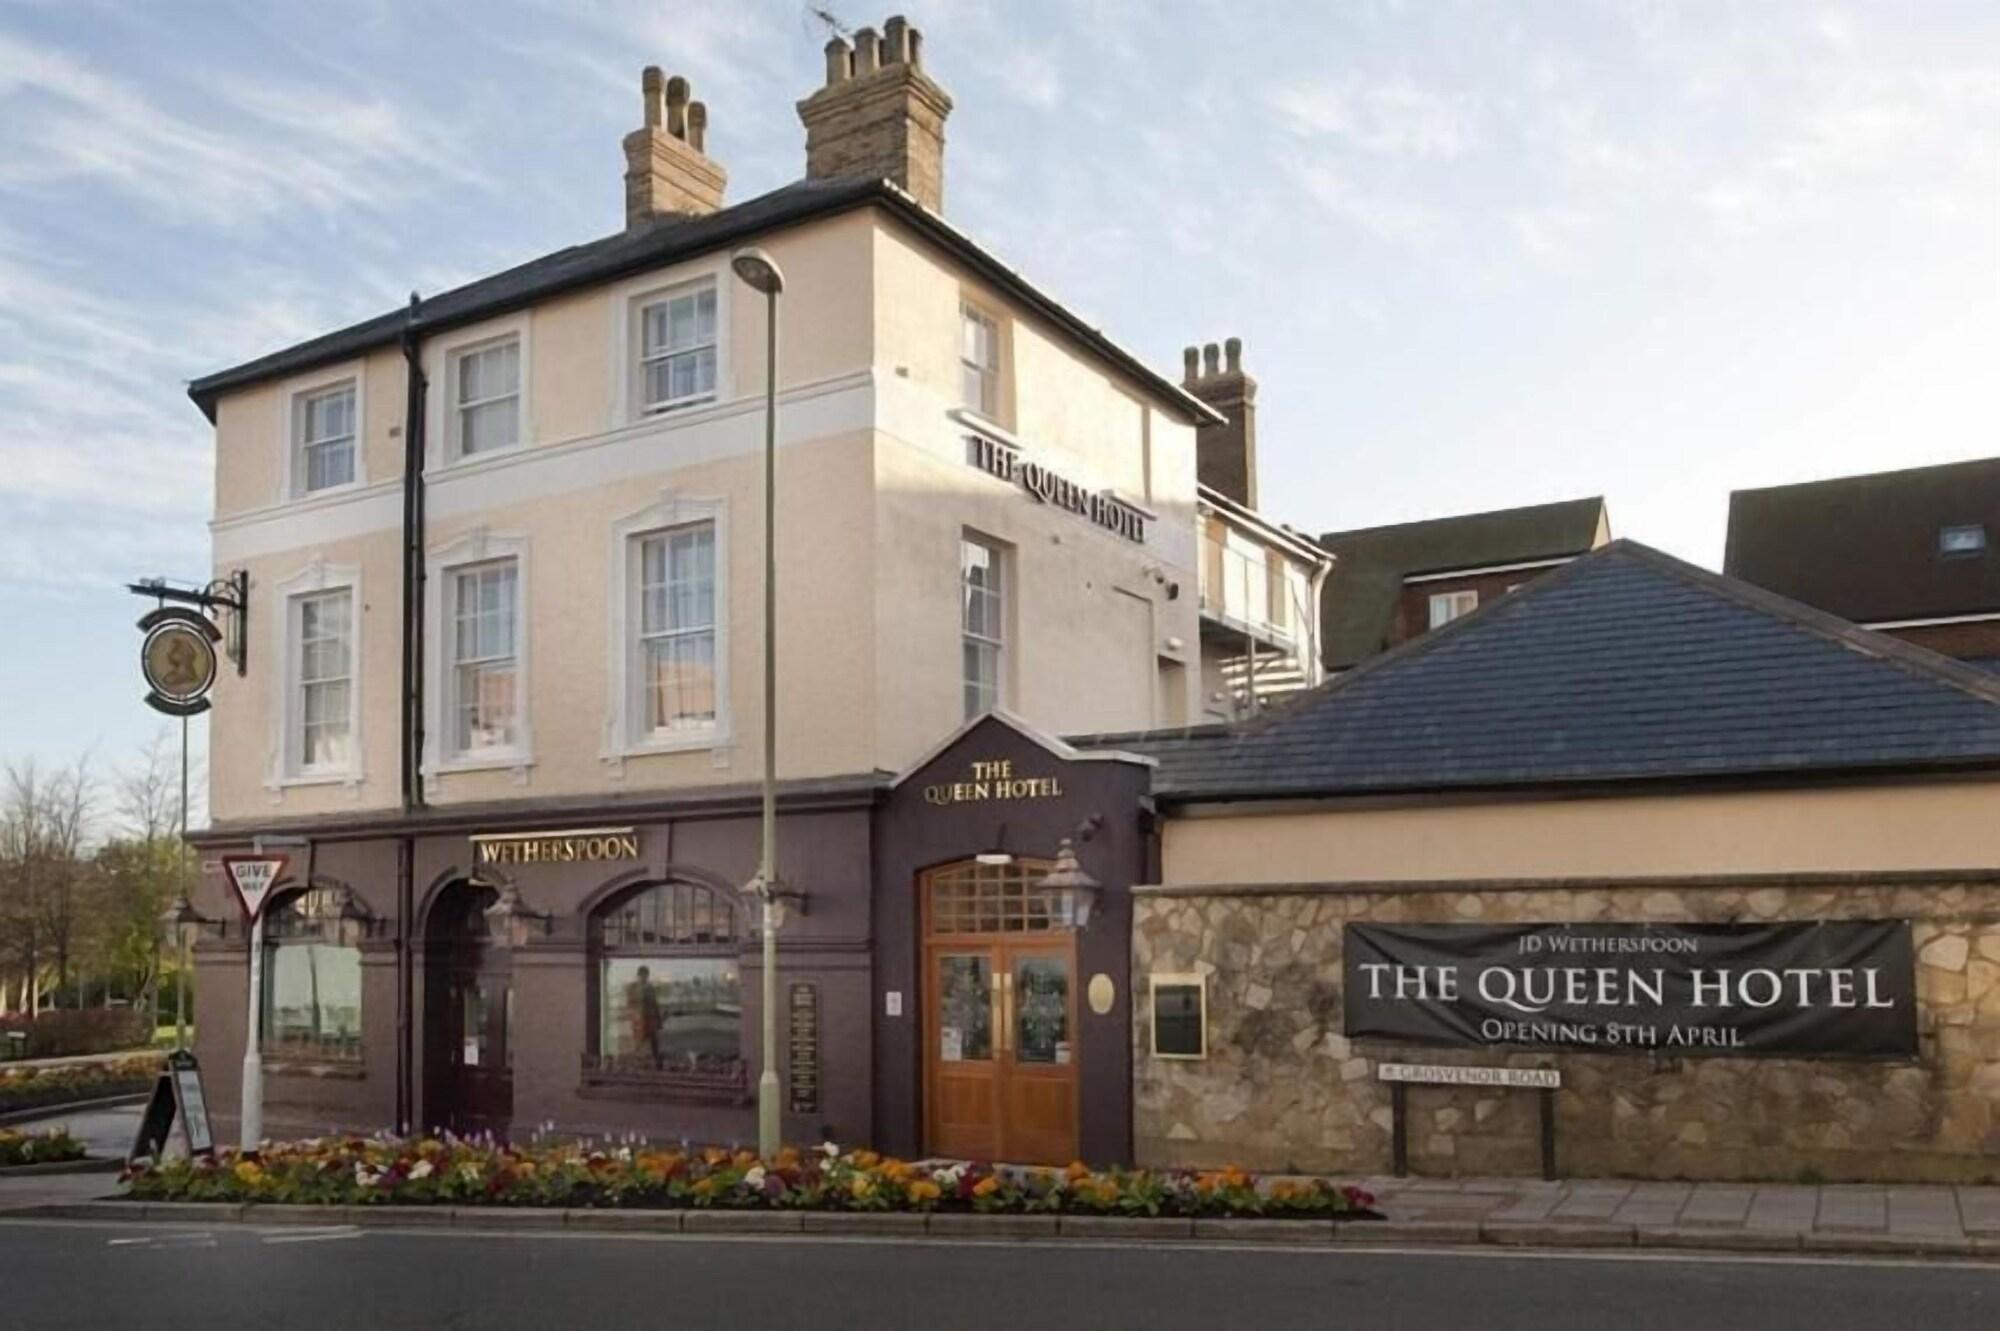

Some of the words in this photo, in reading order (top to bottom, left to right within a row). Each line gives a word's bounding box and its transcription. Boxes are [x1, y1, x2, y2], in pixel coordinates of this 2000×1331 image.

[972, 758, 1011, 780] THE
[924, 782, 990, 805] QUEEN
[996, 777, 1062, 799] HOTEL
[480, 836, 638, 863] WETHERSPOON
[236, 864, 271, 877] GIVE
[1518, 935, 1542, 955] JD
[1548, 936, 1698, 953] WETHERSPOON
[1358, 963, 1458, 1000] THE
[1478, 966, 1664, 1012] QUEEN
[1690, 968, 1894, 1007] HOTEL
[1482, 1018, 1596, 1043] OPENING
[1606, 1022, 1656, 1045] 8TH
[1667, 1024, 1745, 1046] APRIL
[1400, 1066, 1503, 1084] GROSVENOR
[1508, 1070, 1557, 1087] ROAD
